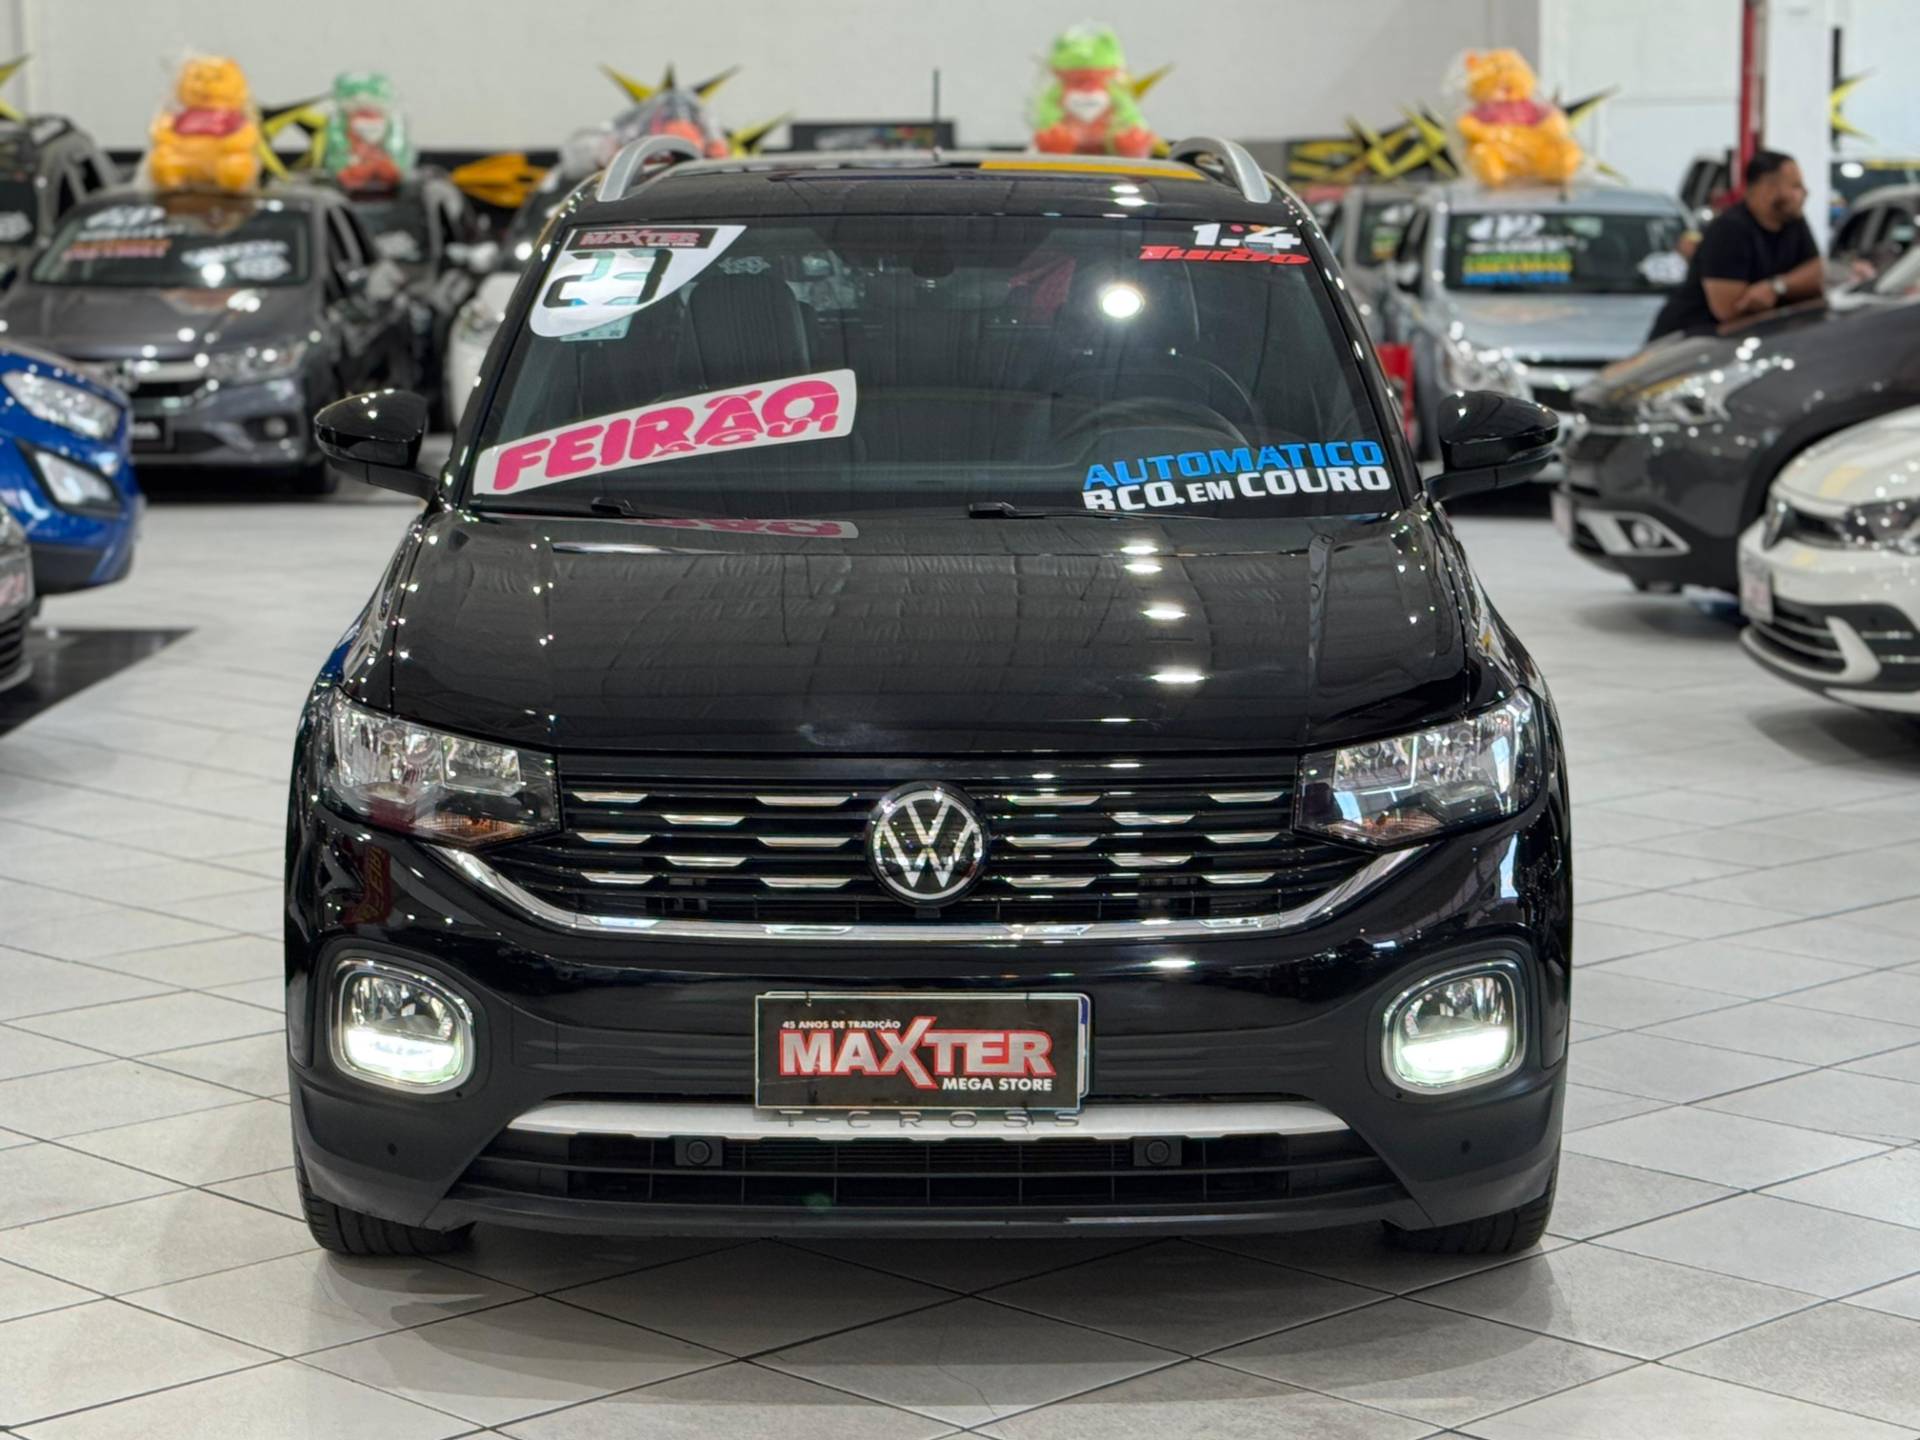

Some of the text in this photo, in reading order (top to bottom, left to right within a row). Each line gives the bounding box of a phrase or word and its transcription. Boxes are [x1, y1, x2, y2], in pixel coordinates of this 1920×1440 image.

[579, 229, 701, 247] MAXTER
[493, 379, 840, 491] FEIRÃO
[1190, 480, 1235, 503] EM
[1237, 466, 1392, 497] COURO
[782, 1019, 901, 1031] 45 ANOS DE TRADIÇÃO
[779, 1016, 1056, 1089] MAXTER
[942, 1078, 1053, 1091] MEGA STORE
[779, 1110, 1081, 1128] T-CROSS
